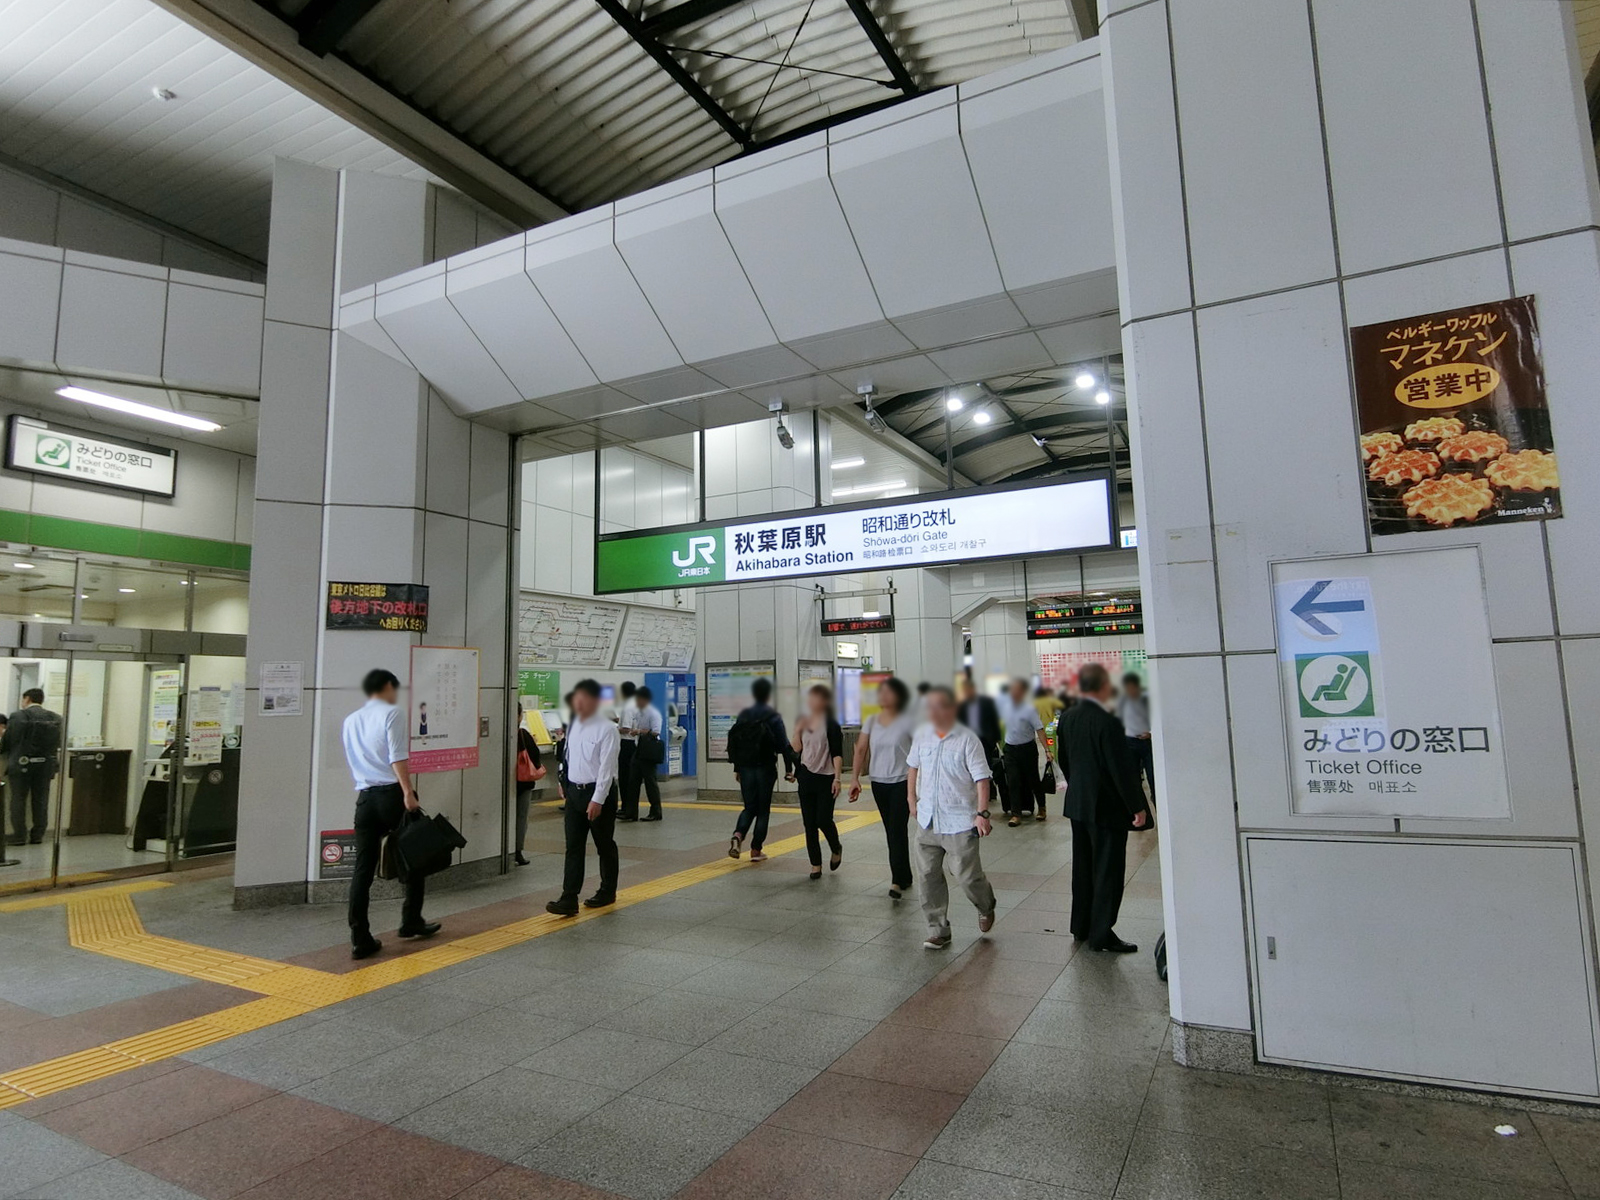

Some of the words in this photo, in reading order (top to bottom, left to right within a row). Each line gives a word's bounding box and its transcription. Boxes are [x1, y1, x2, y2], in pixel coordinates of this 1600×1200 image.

[1386, 312, 1497, 340] ベルギーワッフル
[1380, 331, 1507, 370] マネケン
[1404, 368, 1491, 402] 営業中
[76, 455, 101, 467] Ticket
[103, 462, 127, 473] Office
[77, 443, 152, 468] みどりの窓口
[862, 508, 956, 534] 昭和通り改札
[1497, 506, 1545, 516] Manneken
[735, 523, 826, 555] 秋葉原駅
[863, 533, 919, 547] Shōwa-dōri
[922, 530, 948, 541] Gate
[672, 536, 716, 568] JR
[736, 557, 801, 572] Akihabara
[805, 551, 853, 565] Station
[678, 566, 711, 578] JR東日本
[329, 599, 428, 615] 後方地下の改札口
[1303, 726, 1490, 753] みどりの窓口
[1305, 760, 1360, 774] Ticket
[1366, 759, 1422, 775] Office
[1307, 780, 1354, 793] 售票处
[1369, 781, 1417, 794] 매표소
